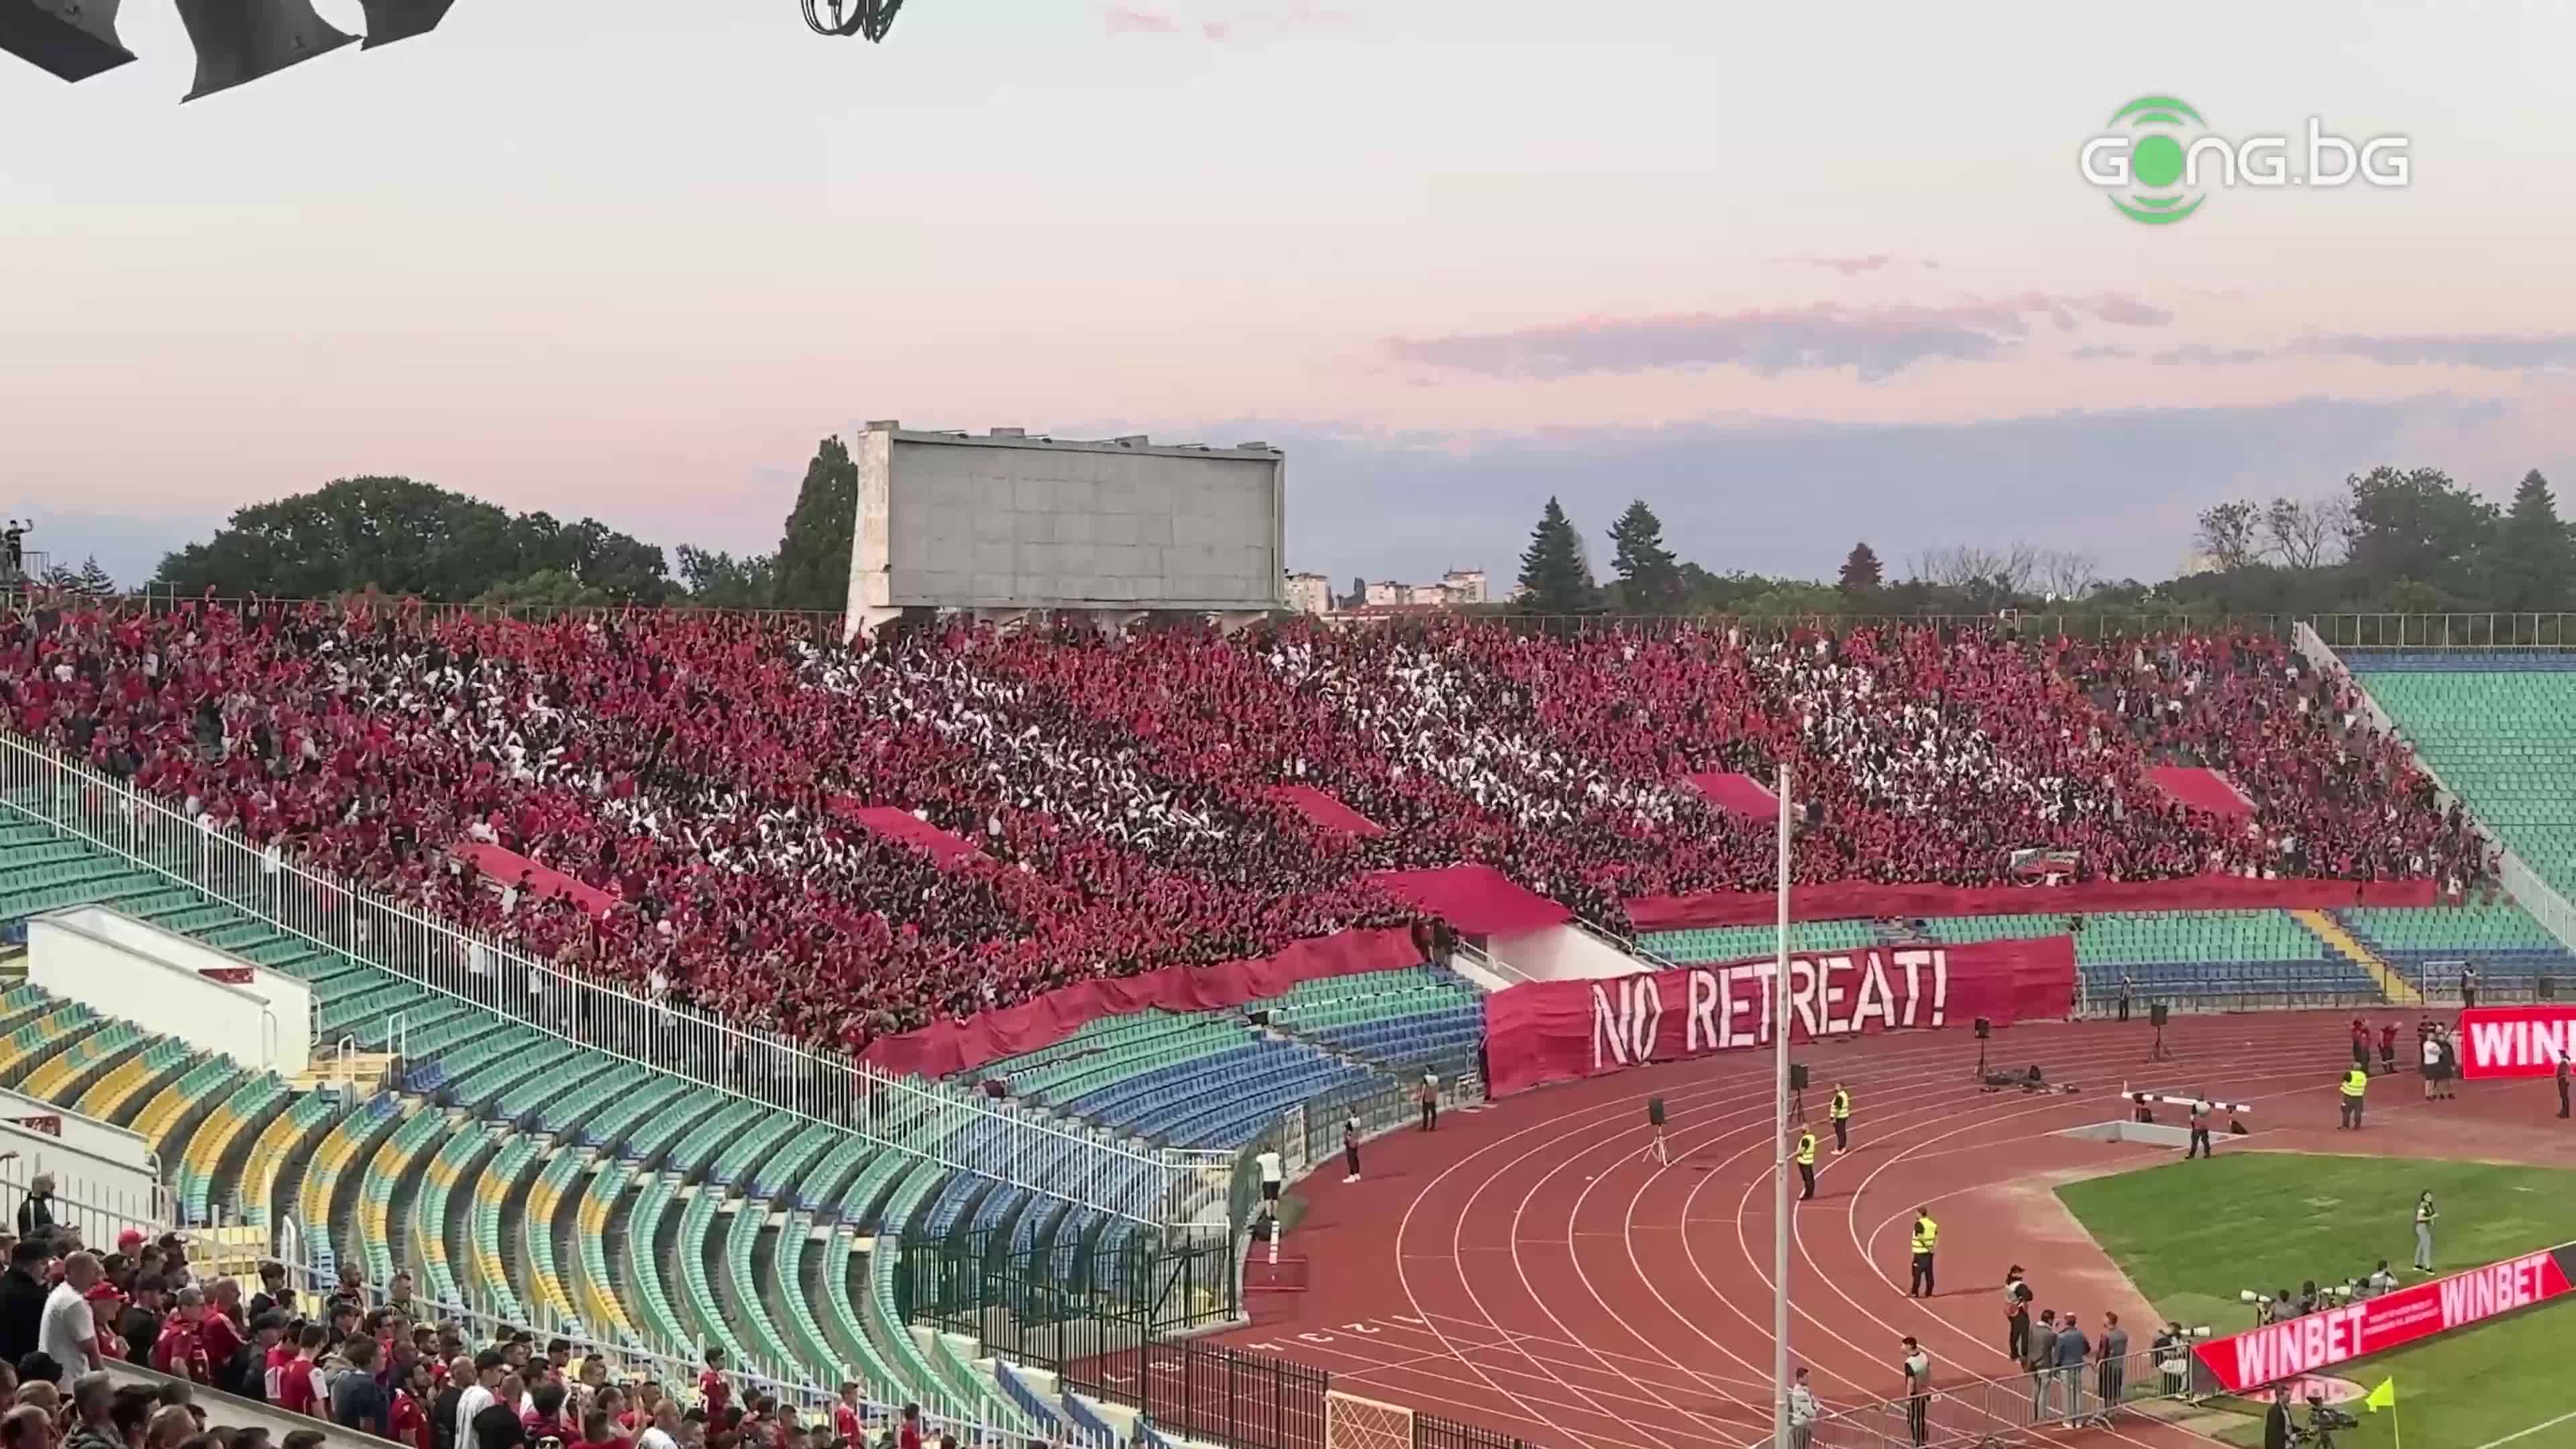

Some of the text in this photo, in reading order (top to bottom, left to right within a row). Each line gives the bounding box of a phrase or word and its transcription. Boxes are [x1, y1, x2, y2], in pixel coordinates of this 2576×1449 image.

[1591, 949, 1947, 1068] NO RETREAT!
[2470, 1019, 2576, 1067] WIN
[2440, 1252, 2548, 1328] WINBET
[2235, 1303, 2366, 1389] WINBET
